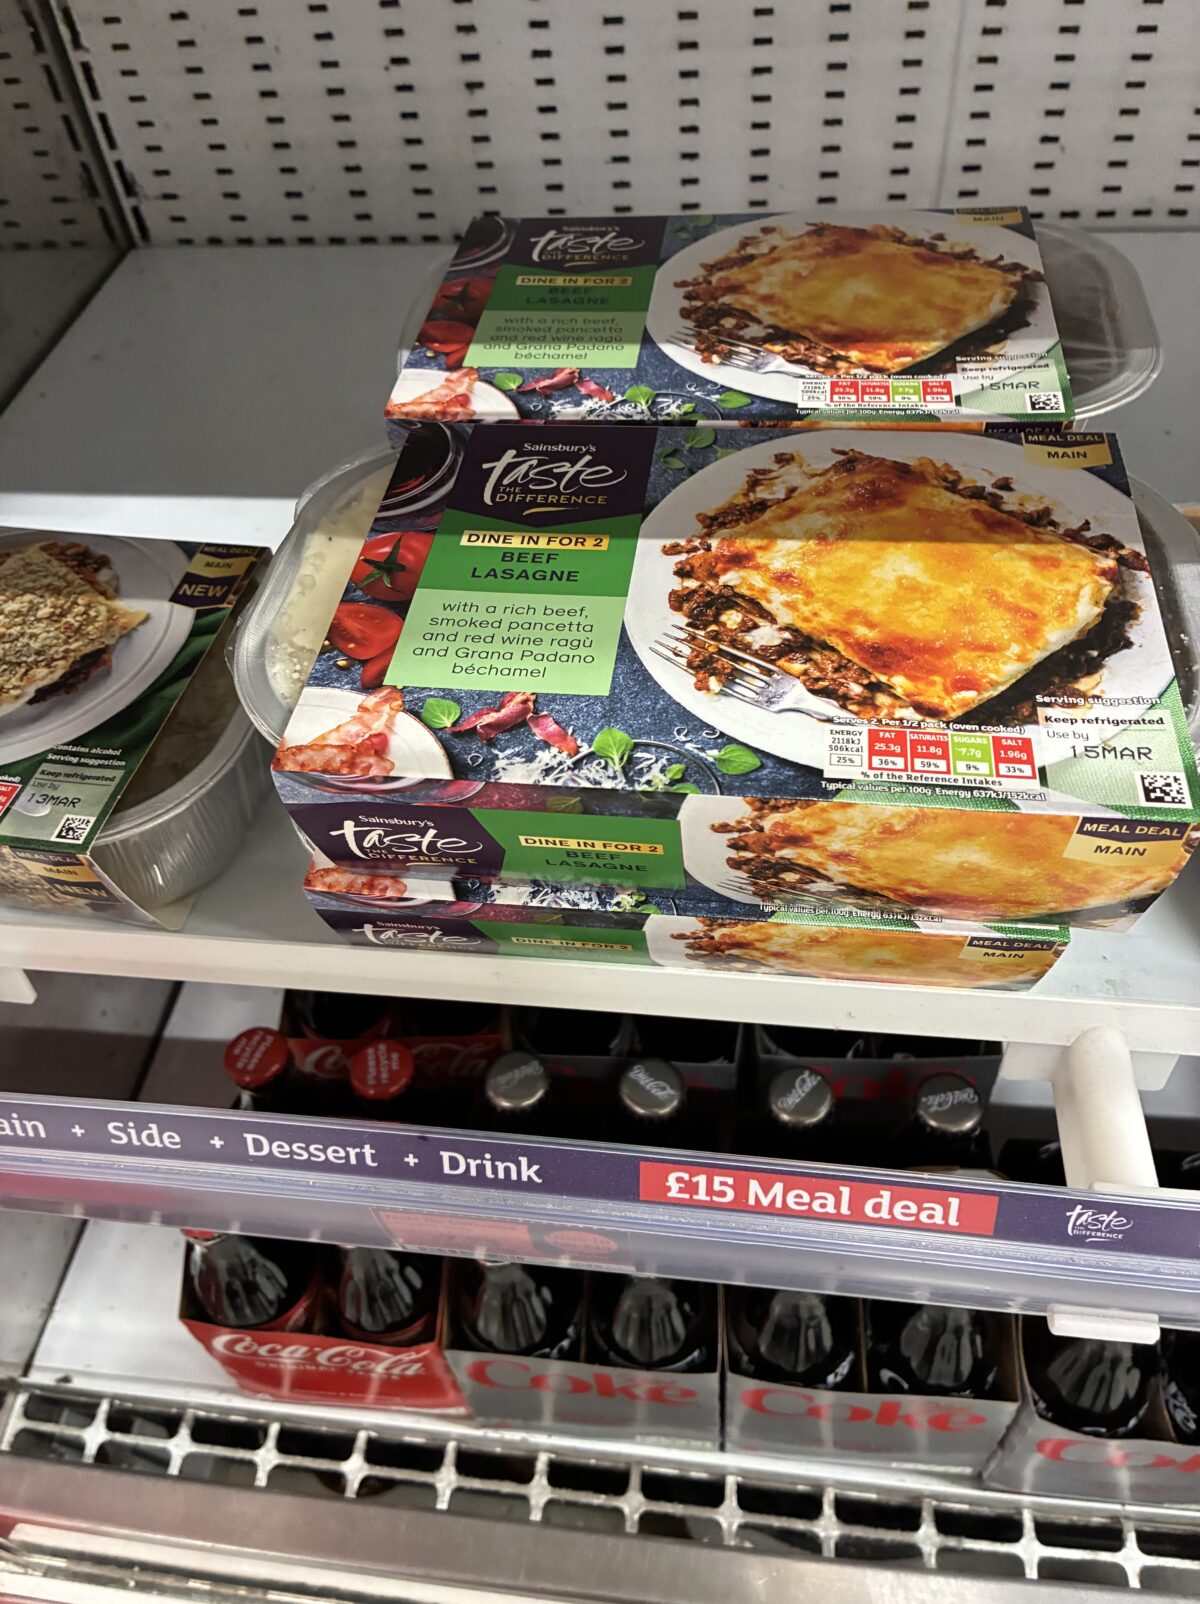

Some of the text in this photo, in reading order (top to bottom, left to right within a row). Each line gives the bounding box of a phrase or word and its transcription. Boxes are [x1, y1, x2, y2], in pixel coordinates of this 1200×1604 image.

[530, 229, 646, 262] taste
[520, 277, 557, 285] DINE
[562, 277, 579, 285] IN
[549, 287, 593, 295] BEEF
[526, 296, 610, 305] LASAGNE
[504, 317, 534, 325] with
[551, 317, 579, 325] rich
[582, 317, 619, 326] beef,
[495, 325, 623, 334] smoked pancetta
[490, 334, 517, 342] and
[522, 334, 547, 342] red
[515, 343, 563, 351] Grana
[514, 351, 588, 360] béchamel
[988, 363, 1050, 372] refrigerated
[980, 381, 1041, 391] 15MAR
[522, 442, 597, 453] Sainsbury's
[1047, 451, 1088, 459] MAIN
[482, 450, 628, 506] taste
[495, 494, 608, 505] DIFFERENCE
[466, 533, 604, 547] DINE IN FOR 2
[500, 551, 559, 564] BEEF
[204, 561, 233, 569] MAIN
[470, 567, 580, 583] LASAGNE
[179, 583, 228, 597] NEW
[441, 601, 589, 619] with a rich beef,
[428, 616, 594, 633] smoked pancetta
[422, 630, 593, 651] and red wine ragù
[412, 645, 595, 664] and Grana Padano
[451, 662, 547, 679] béchamel
[1035, 694, 1161, 706] Serving suggestion
[833, 716, 1026, 735] Serves Per 1/2 pack (oven cooked)
[1044, 715, 1165, 727] Keep refrigerated
[831, 737, 861, 745] 2118kJ
[879, 731, 896, 739] FAT
[909, 733, 949, 742] SATURATES
[953, 736, 988, 745] SUGARS
[1001, 738, 1023, 746] SALT
[1047, 730, 1089, 741] Use by
[90, 747, 122, 756] alcohol
[828, 745, 863, 753] 506kcal
[873, 743, 901, 753] 25.3g
[916, 745, 943, 756] 11.8g
[999, 750, 1028, 760] 1.96g
[1070, 745, 1153, 761] 15MAR
[46, 753, 126, 767] Serving suggestion
[836, 756, 1025, 774] 25% 36% 59% 9% 33%
[39, 769, 117, 783] Keep refrigerated
[861, 771, 870, 779] %
[886, 772, 903, 780] the
[906, 773, 959, 784] Reference
[962, 777, 1003, 787] Intakes
[32, 781, 60, 790] Use by
[821, 780, 1046, 802] Typical values per Energy 637kJ/152kcal
[27, 793, 82, 808] 13MAR
[358, 815, 435, 828] Sainsbury's
[1082, 823, 1182, 837] MEAL DEAL
[329, 820, 483, 860] taste
[524, 837, 659, 853] DINE IN FOR 2
[565, 850, 621, 861] BEEF
[1093, 845, 1147, 857] MAIN
[368, 853, 478, 865] DIFFERENCE
[545, 858, 648, 872] LASAGNE
[352, 923, 481, 945] taste
[972, 939, 1049, 949] MEAL DEAL
[982, 951, 1025, 959] MAIN
[0, 1112, 47, 1138] ain
[106, 1121, 182, 1149] Side
[243, 1132, 378, 1168] Dessert
[439, 1150, 543, 1184] Drink
[665, 1171, 960, 1227] £15 Meal deal
[1066, 1204, 1134, 1237] taste
[1073, 1229, 1124, 1240] DIFFERENCE
[211, 1333, 431, 1377] Coca-Cola
[466, 1358, 699, 1408] Coke
[739, 1387, 988, 1433] Coke
